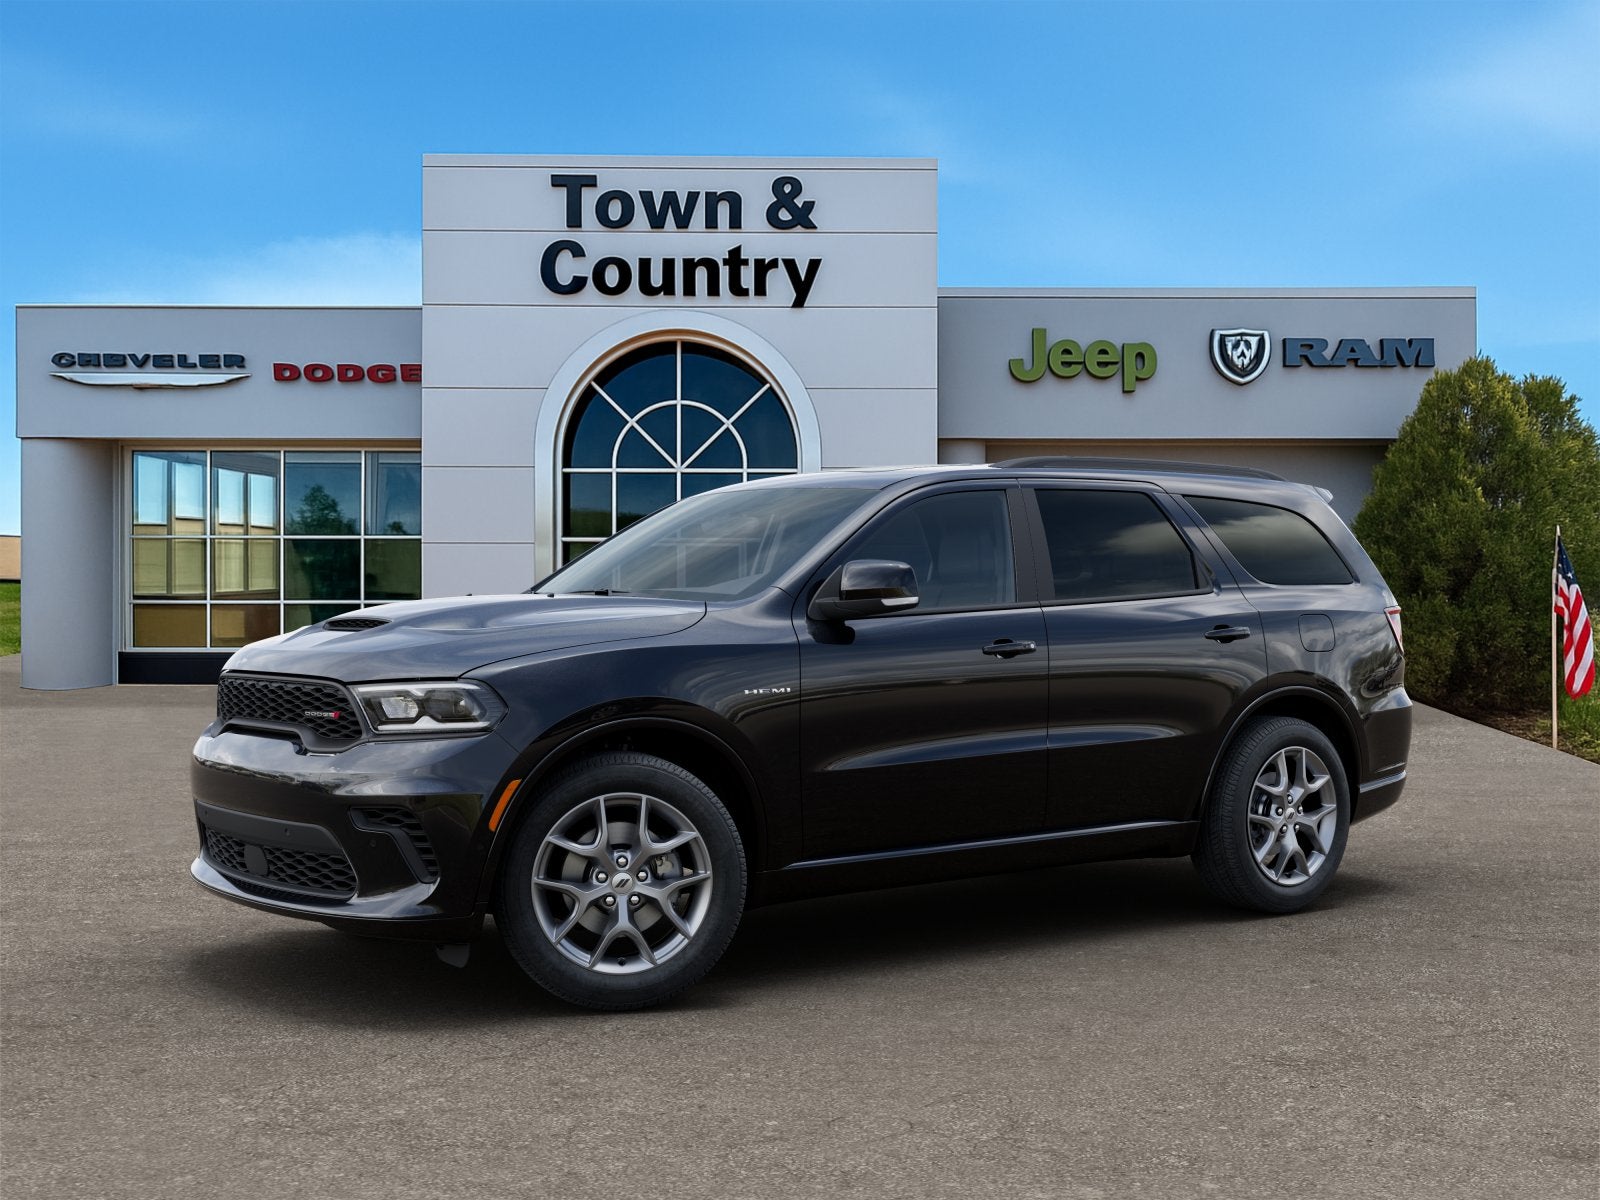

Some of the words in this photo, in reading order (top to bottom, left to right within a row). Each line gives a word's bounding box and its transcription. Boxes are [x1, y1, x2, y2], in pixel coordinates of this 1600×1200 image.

[550, 173, 743, 229] Town
[765, 175, 818, 230] &
[539, 239, 823, 308] Country
[272, 362, 422, 384] DODGE
[1009, 327, 1157, 392] Jeep
[1282, 337, 1435, 368] RAM
[744, 687, 791, 695] HEMI
